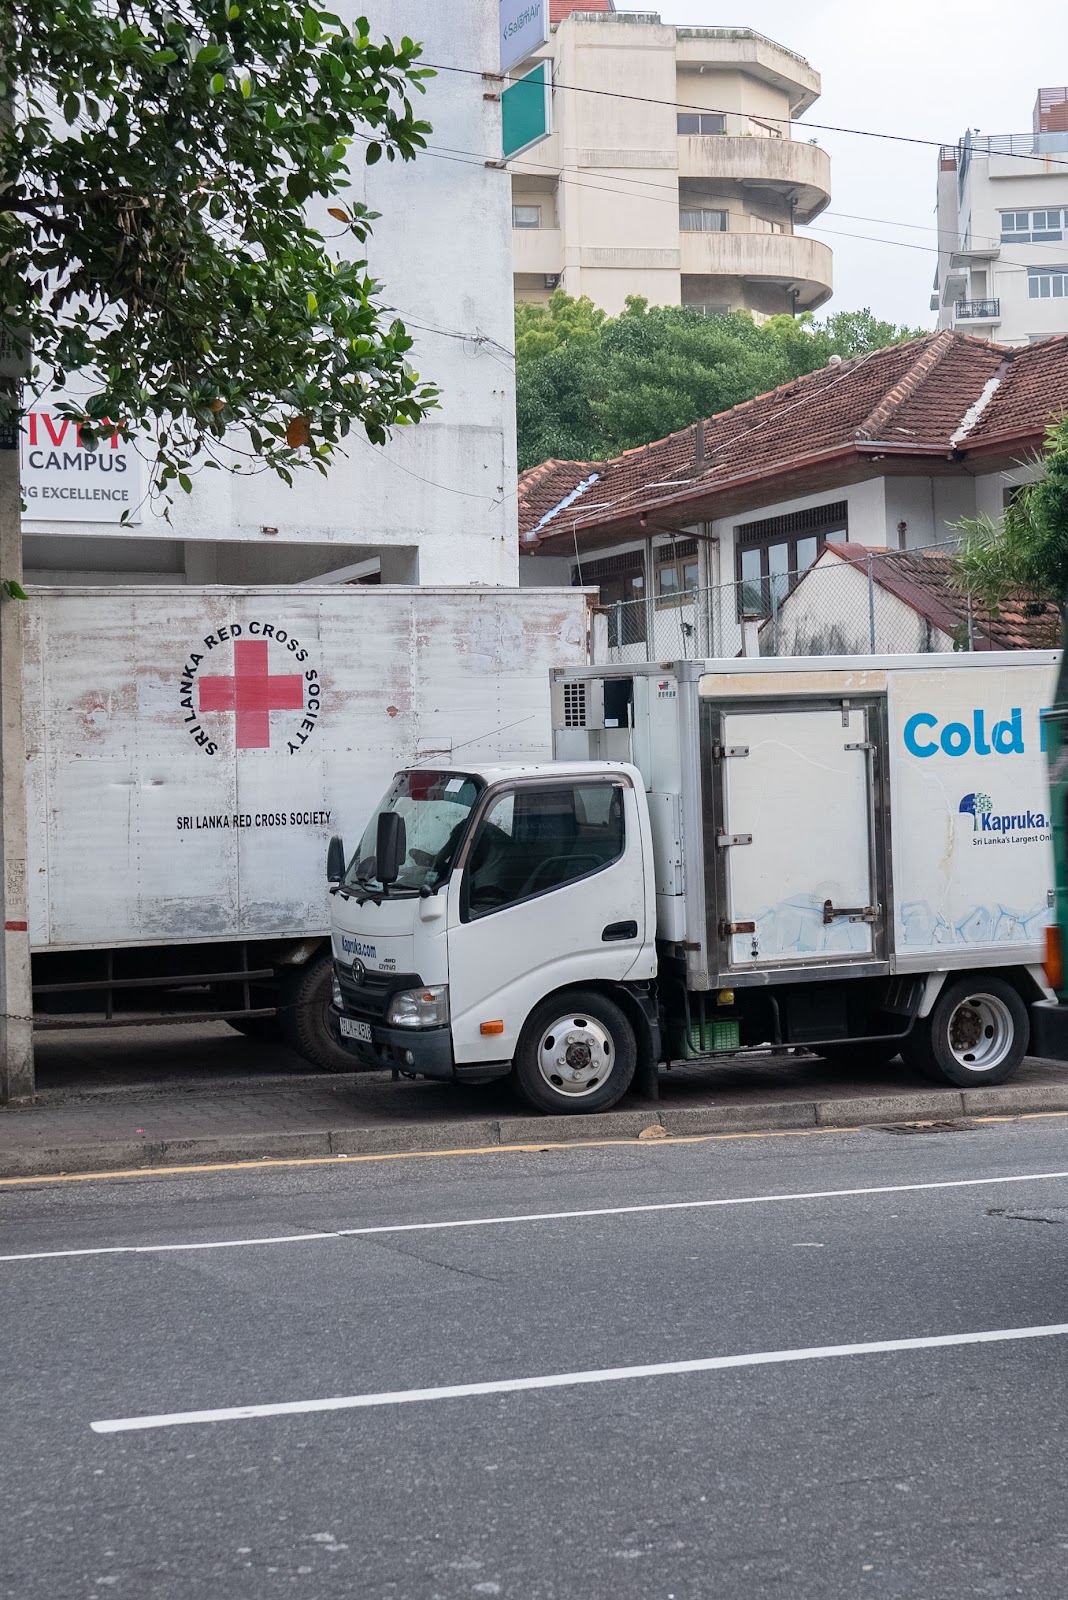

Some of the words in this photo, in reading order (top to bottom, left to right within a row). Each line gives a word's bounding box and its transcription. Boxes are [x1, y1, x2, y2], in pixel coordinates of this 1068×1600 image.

[28, 450, 127, 473] CAMPUS
[42, 487, 129, 501] EXCELLENCE
[203, 624, 242, 650] RED
[249, 621, 309, 662] CROSS
[180, 652, 204, 723] LANKA
[287, 669, 321, 755] SOCIETY
[189, 725, 218, 755] SRI
[903, 707, 1025, 758] Cold
[176, 816, 193, 830] SRI
[196, 815, 230, 829] LANKA
[233, 814, 251, 828] RED
[254, 813, 287, 827] CROSS
[290, 811, 332, 826] SOCIETY
[972, 837, 983, 846] Sri
[984, 836, 1011, 845] Lanka's
[1011, 835, 1038, 845] Largest
[341, 935, 377, 959] Kapruka.com
[378, 963, 396, 971] DYNA
